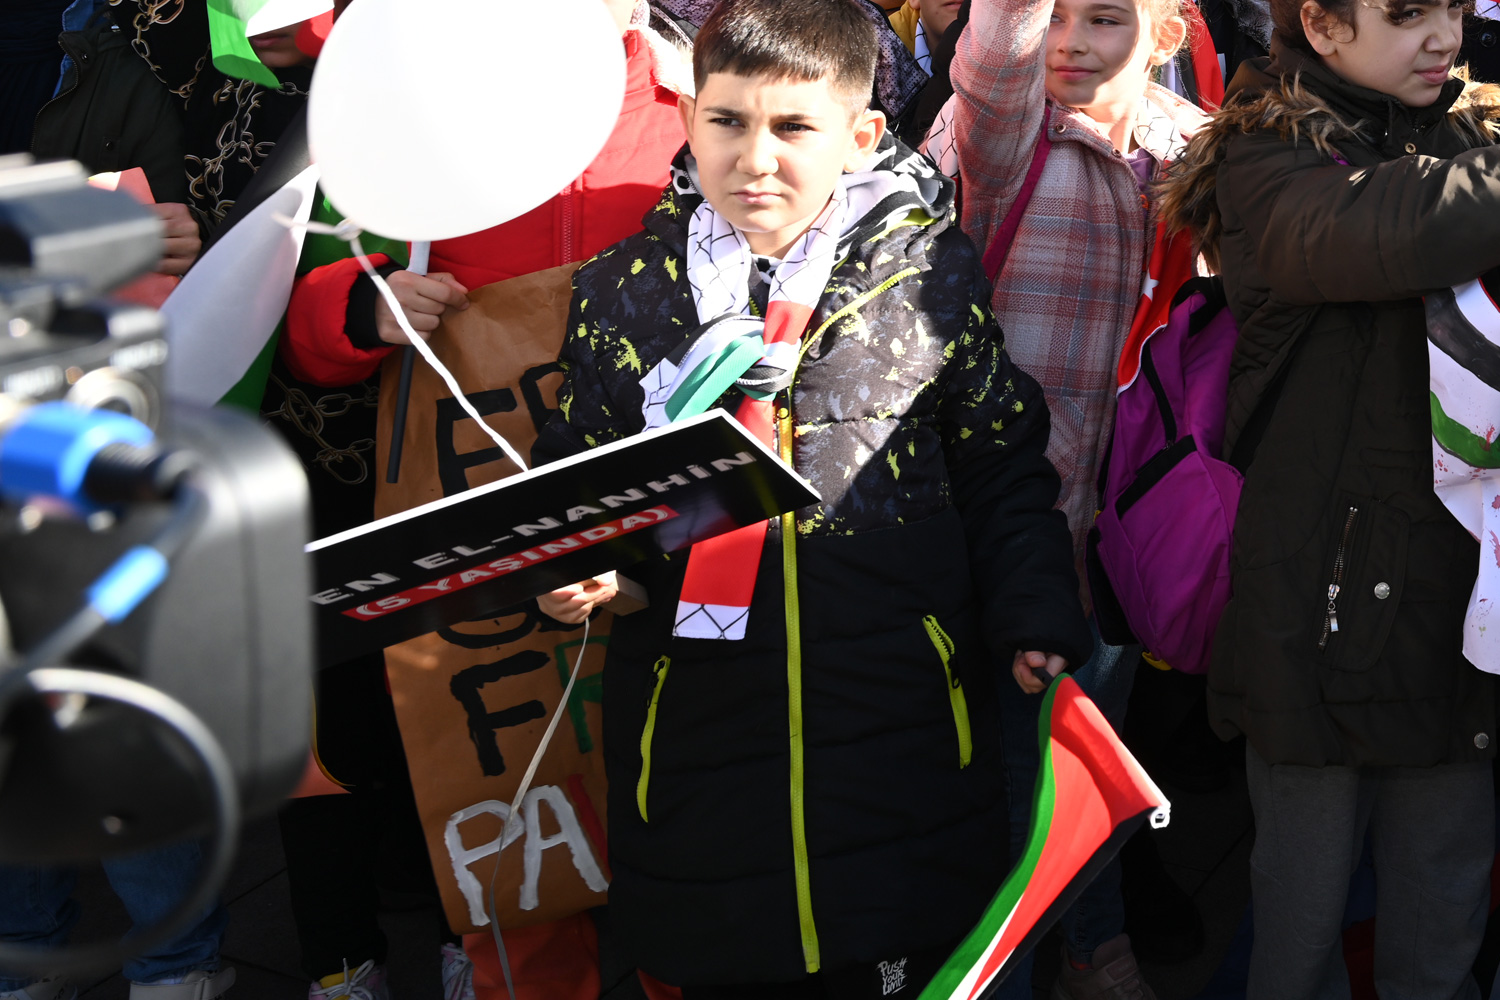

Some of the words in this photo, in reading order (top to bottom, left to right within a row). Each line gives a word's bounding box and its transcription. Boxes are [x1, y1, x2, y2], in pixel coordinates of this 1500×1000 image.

[355, 592, 411, 617] (5
[419, 507, 671, 593] YAŞINDA)
[412, 450, 758, 571] EL-NANHİN
